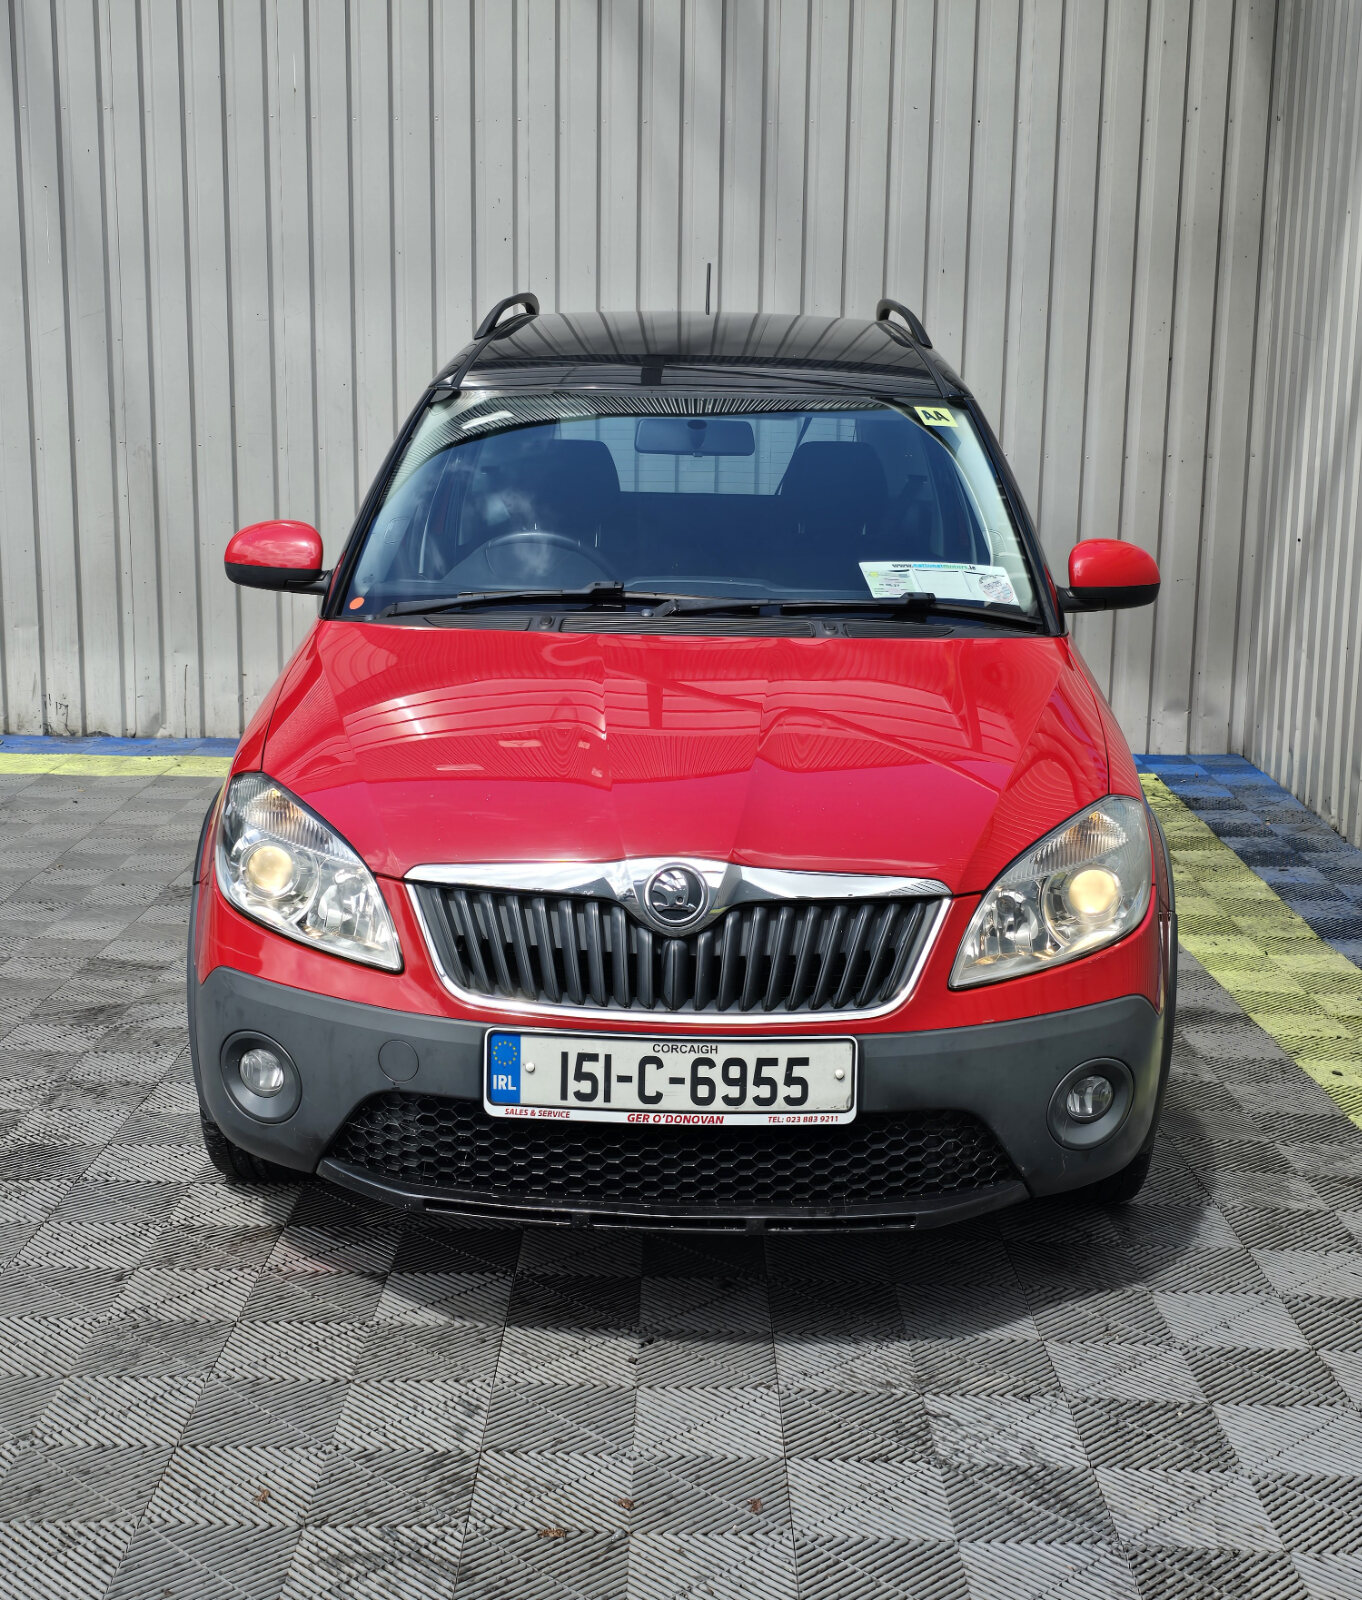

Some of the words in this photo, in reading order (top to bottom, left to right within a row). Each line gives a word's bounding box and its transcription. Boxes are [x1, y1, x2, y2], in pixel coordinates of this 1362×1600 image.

[921, 410, 950, 421] AA
[652, 1043, 718, 1055] CORCAIGH
[492, 1074, 517, 1091] IRL
[560, 1051, 810, 1107] 151-C-6955
[504, 1108, 529, 1116] SALES
[538, 1110, 571, 1118] SERVICE
[627, 1113, 650, 1123] GER
[652, 1114, 725, 1125] O'DONOVAN
